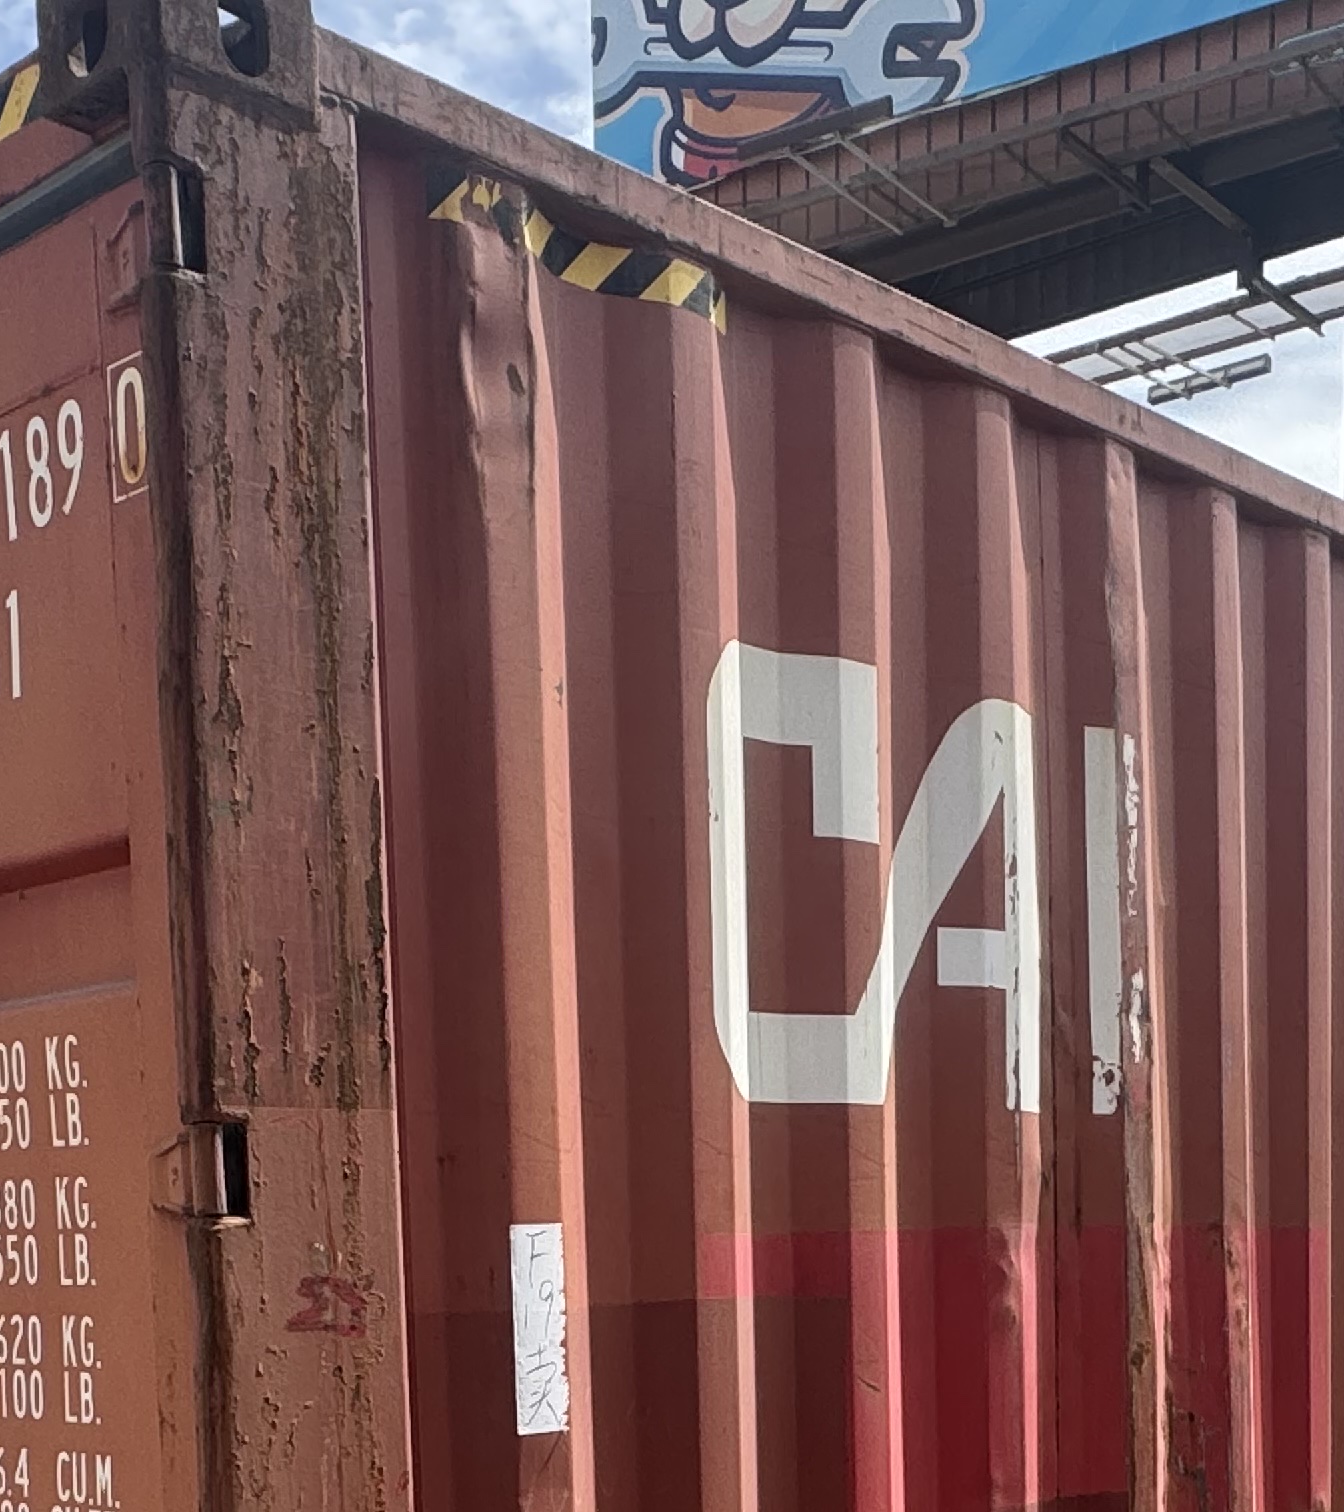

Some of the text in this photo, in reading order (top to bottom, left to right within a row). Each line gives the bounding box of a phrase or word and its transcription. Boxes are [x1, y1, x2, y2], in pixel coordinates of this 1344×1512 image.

[117, 367, 147, 484] 0
[707, 639, 1146, 1116] CAI
[44, 1034, 87, 1089] KG.
[49, 1093, 89, 1147] LB.
[55, 1176, 96, 1229] KG.
[58, 1233, 97, 1286] LB.
[62, 1314, 101, 1369] KG.
[64, 1371, 101, 1424] LB.
[55, 1451, 120, 1508] CU.M.
